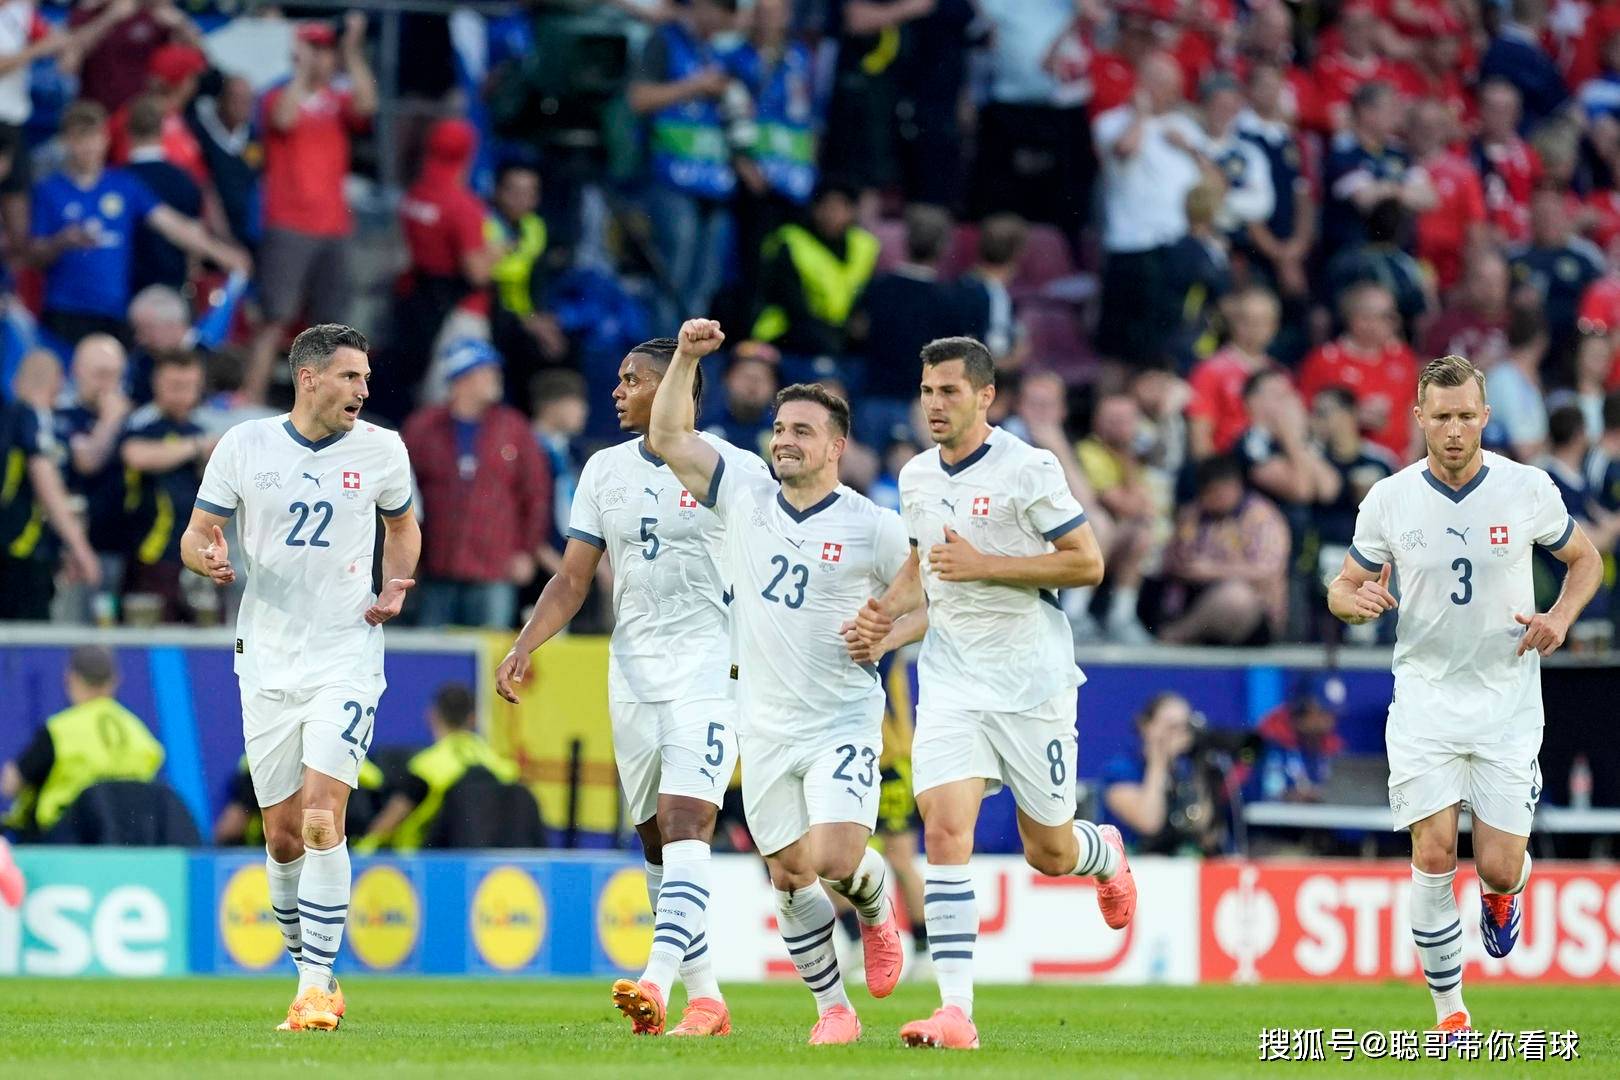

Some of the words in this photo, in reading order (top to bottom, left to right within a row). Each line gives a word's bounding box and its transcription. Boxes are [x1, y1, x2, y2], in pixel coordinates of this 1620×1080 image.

[286, 501, 334, 548] 22
[640, 517, 660, 561] 5
[761, 554, 810, 609] 23
[1450, 557, 1473, 605] 3
[705, 721, 725, 767] 5
[832, 743, 877, 788] 23
[1046, 738, 1066, 786] 8
[0, 884, 170, 977] se
[305, 928, 334, 942] SUISSE
